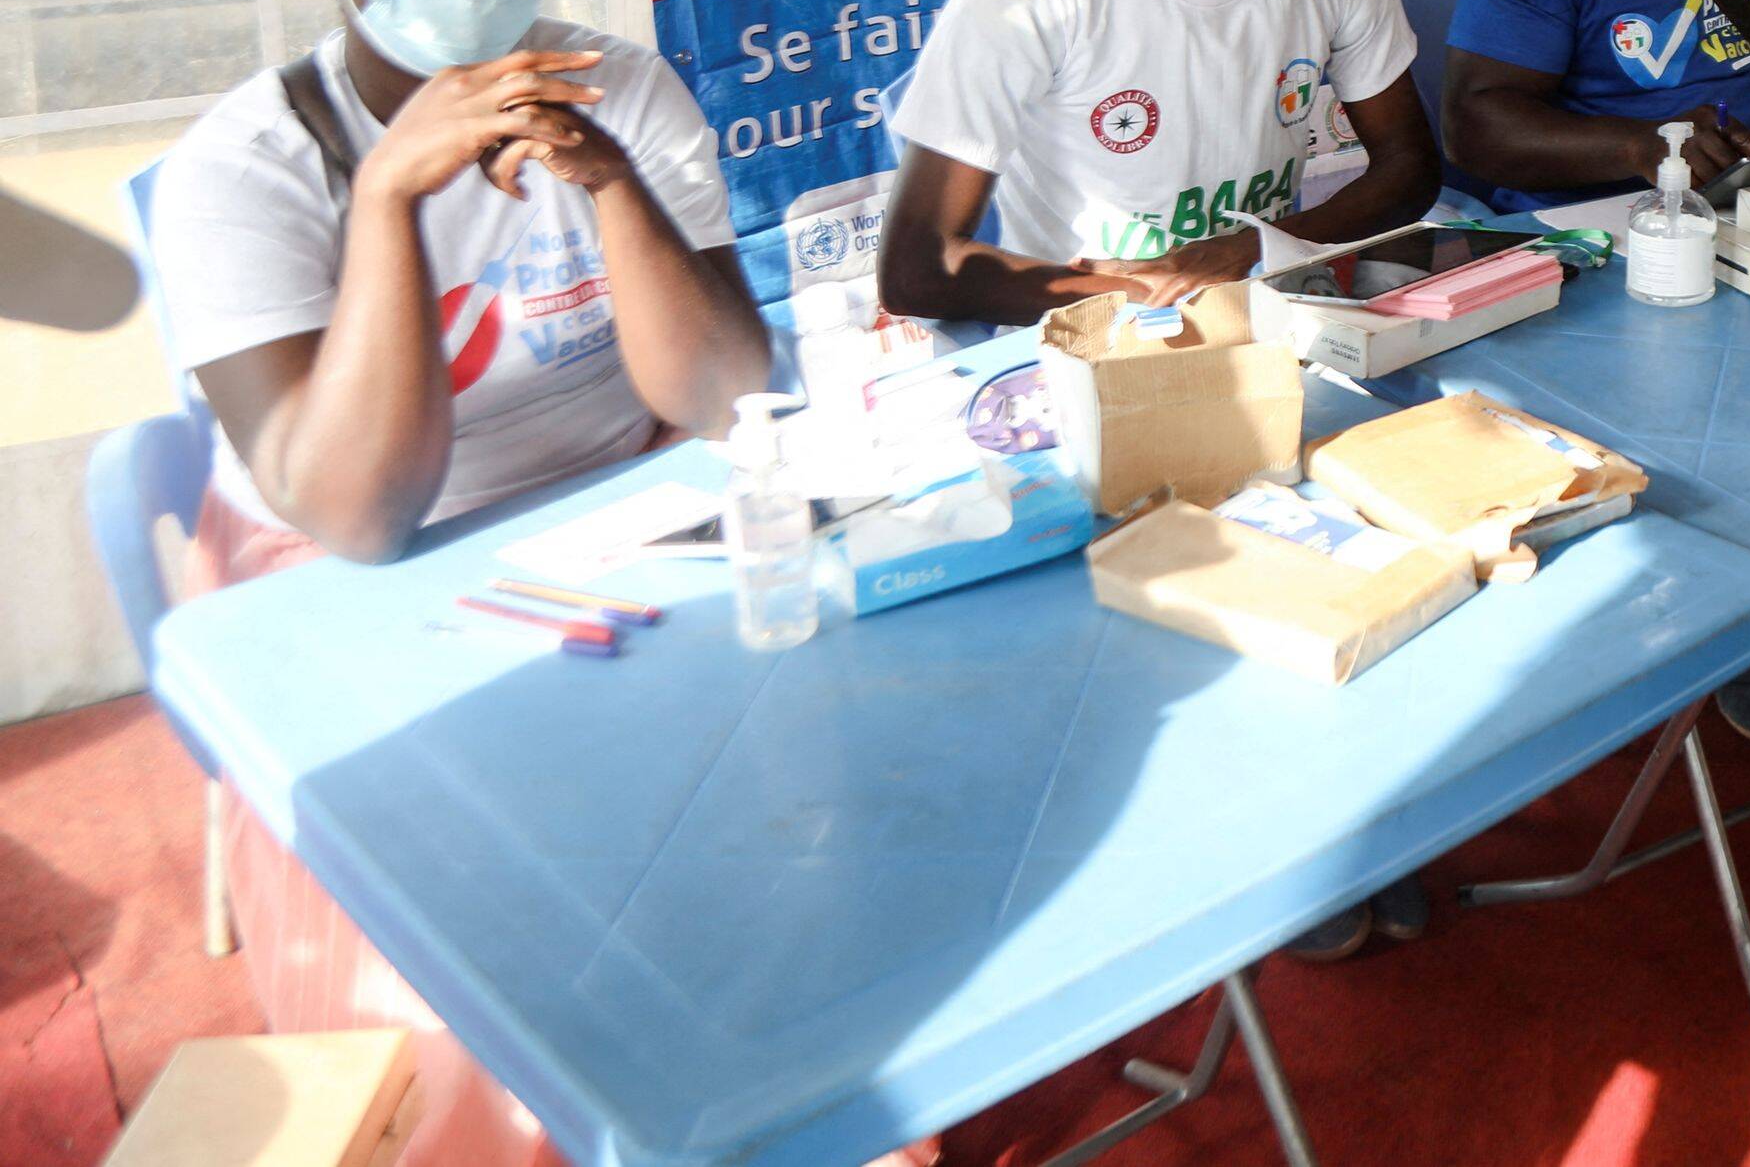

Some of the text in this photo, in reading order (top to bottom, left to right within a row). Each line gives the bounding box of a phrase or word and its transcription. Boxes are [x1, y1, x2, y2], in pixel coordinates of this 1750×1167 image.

[739, 23, 813, 84] Se
[726, 96, 832, 159] our
[1169, 157, 1297, 239] BARA
[854, 234, 880, 252] Org
